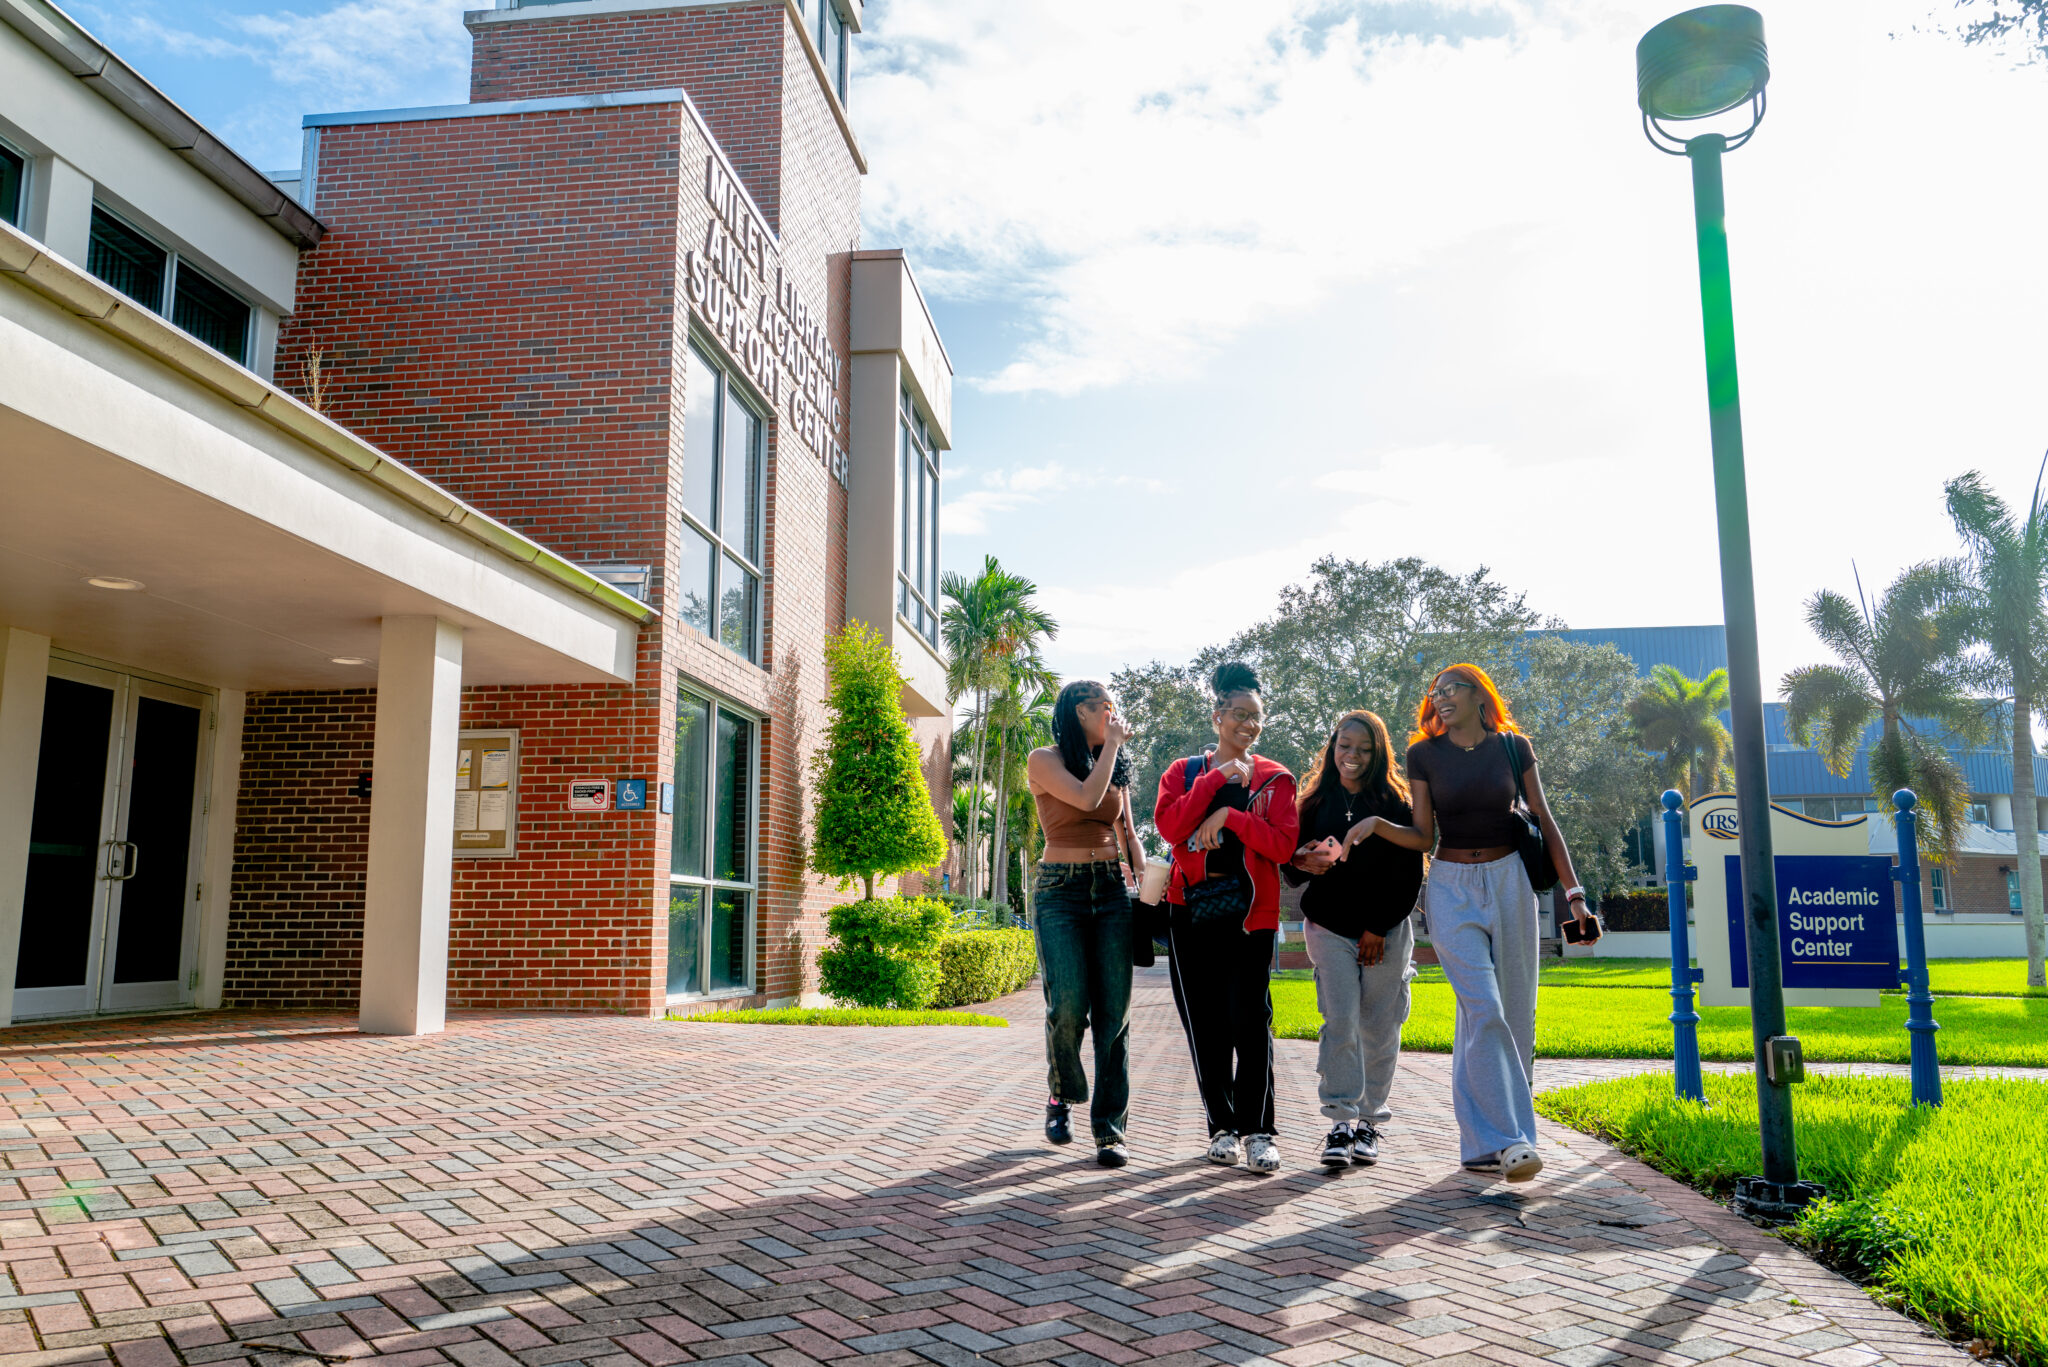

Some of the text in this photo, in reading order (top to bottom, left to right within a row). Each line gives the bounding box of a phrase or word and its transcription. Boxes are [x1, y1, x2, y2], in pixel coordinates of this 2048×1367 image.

[706, 155, 842, 391] MILEY LIBRARY
[704, 218, 842, 435] AND ACADEMIC
[686, 250, 849, 492] SUPPORT CENTER
[1708, 814, 1739, 830] IRS
[1788, 886, 1880, 906] Academic
[1789, 911, 1865, 935] Support
[1791, 937, 1853, 957] Center
